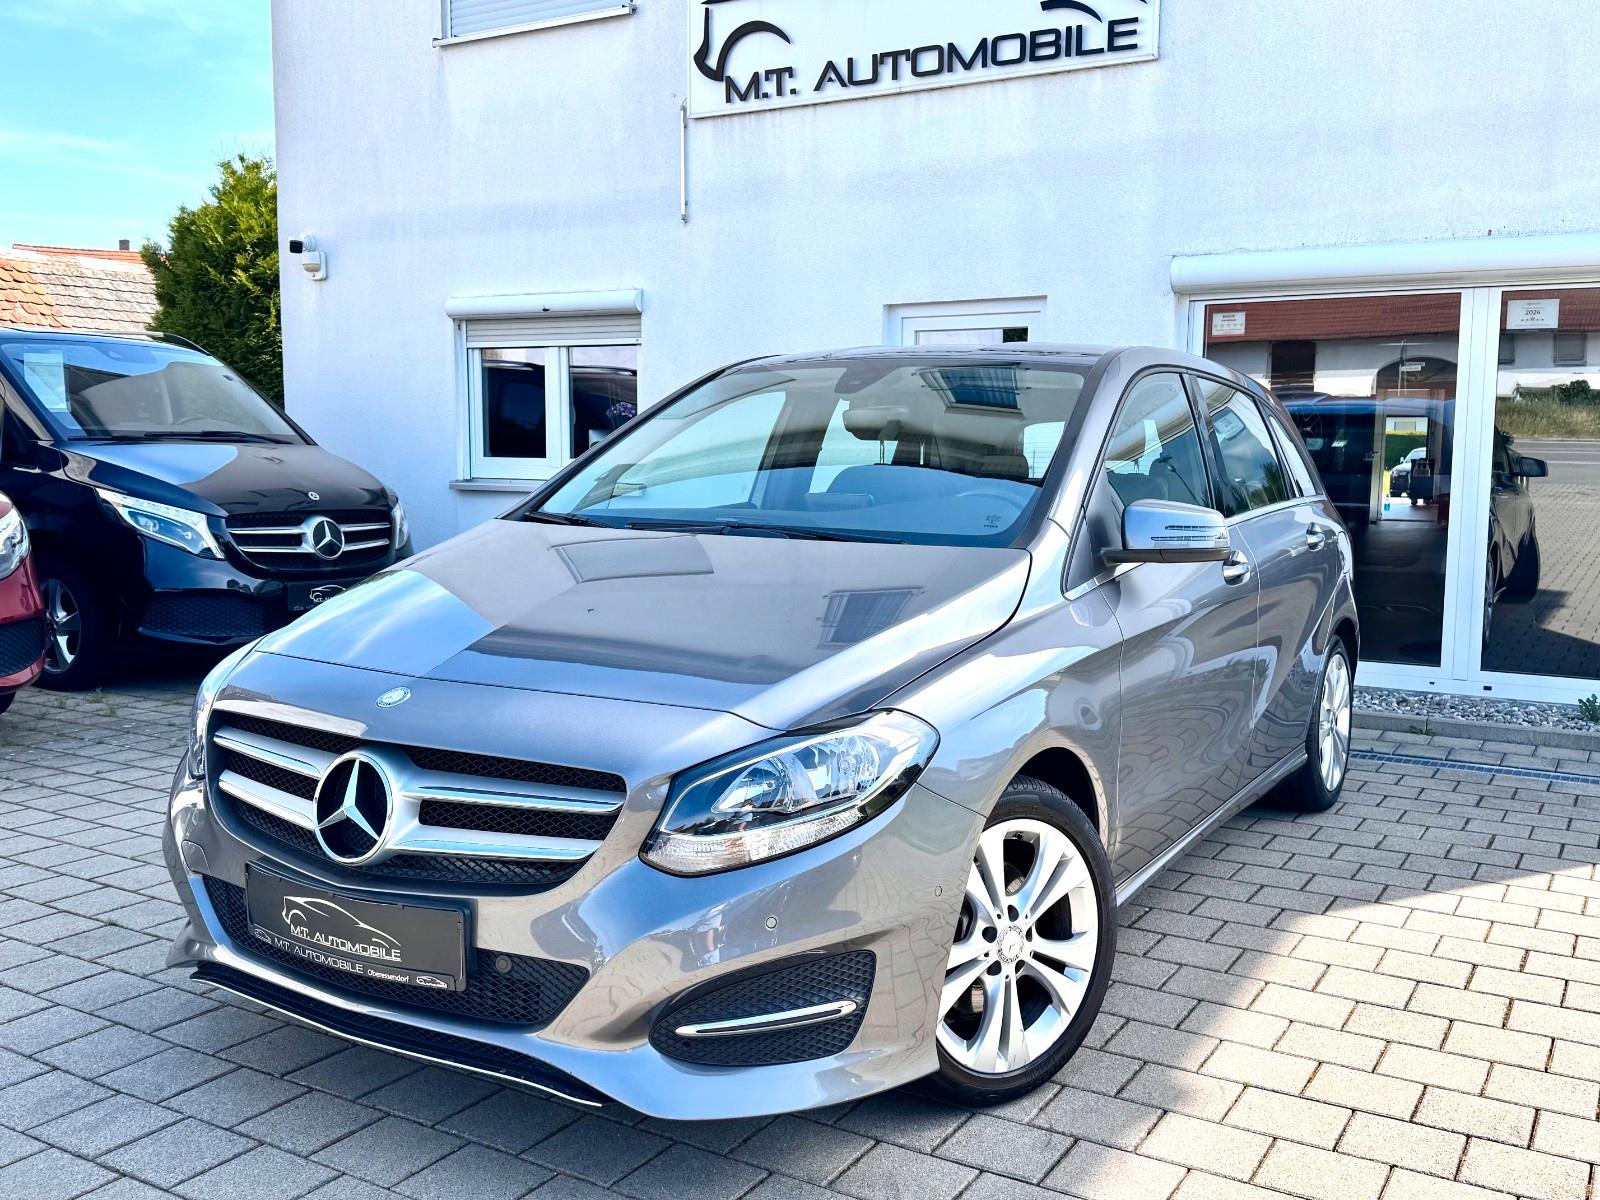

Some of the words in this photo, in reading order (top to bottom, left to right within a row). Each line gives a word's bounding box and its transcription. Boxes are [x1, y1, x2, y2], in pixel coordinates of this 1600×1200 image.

[725, 66, 797, 103] M.T.
[813, 17, 1139, 91] AUTOMOBILE
[275, 937, 291, 951] M.T.
[294, 946, 364, 974] AUTOMOBILE
[368, 968, 410, 983] Oberessendorf
[290, 923, 310, 939] M.T.
[314, 932, 401, 960] AUTOMOBILE
